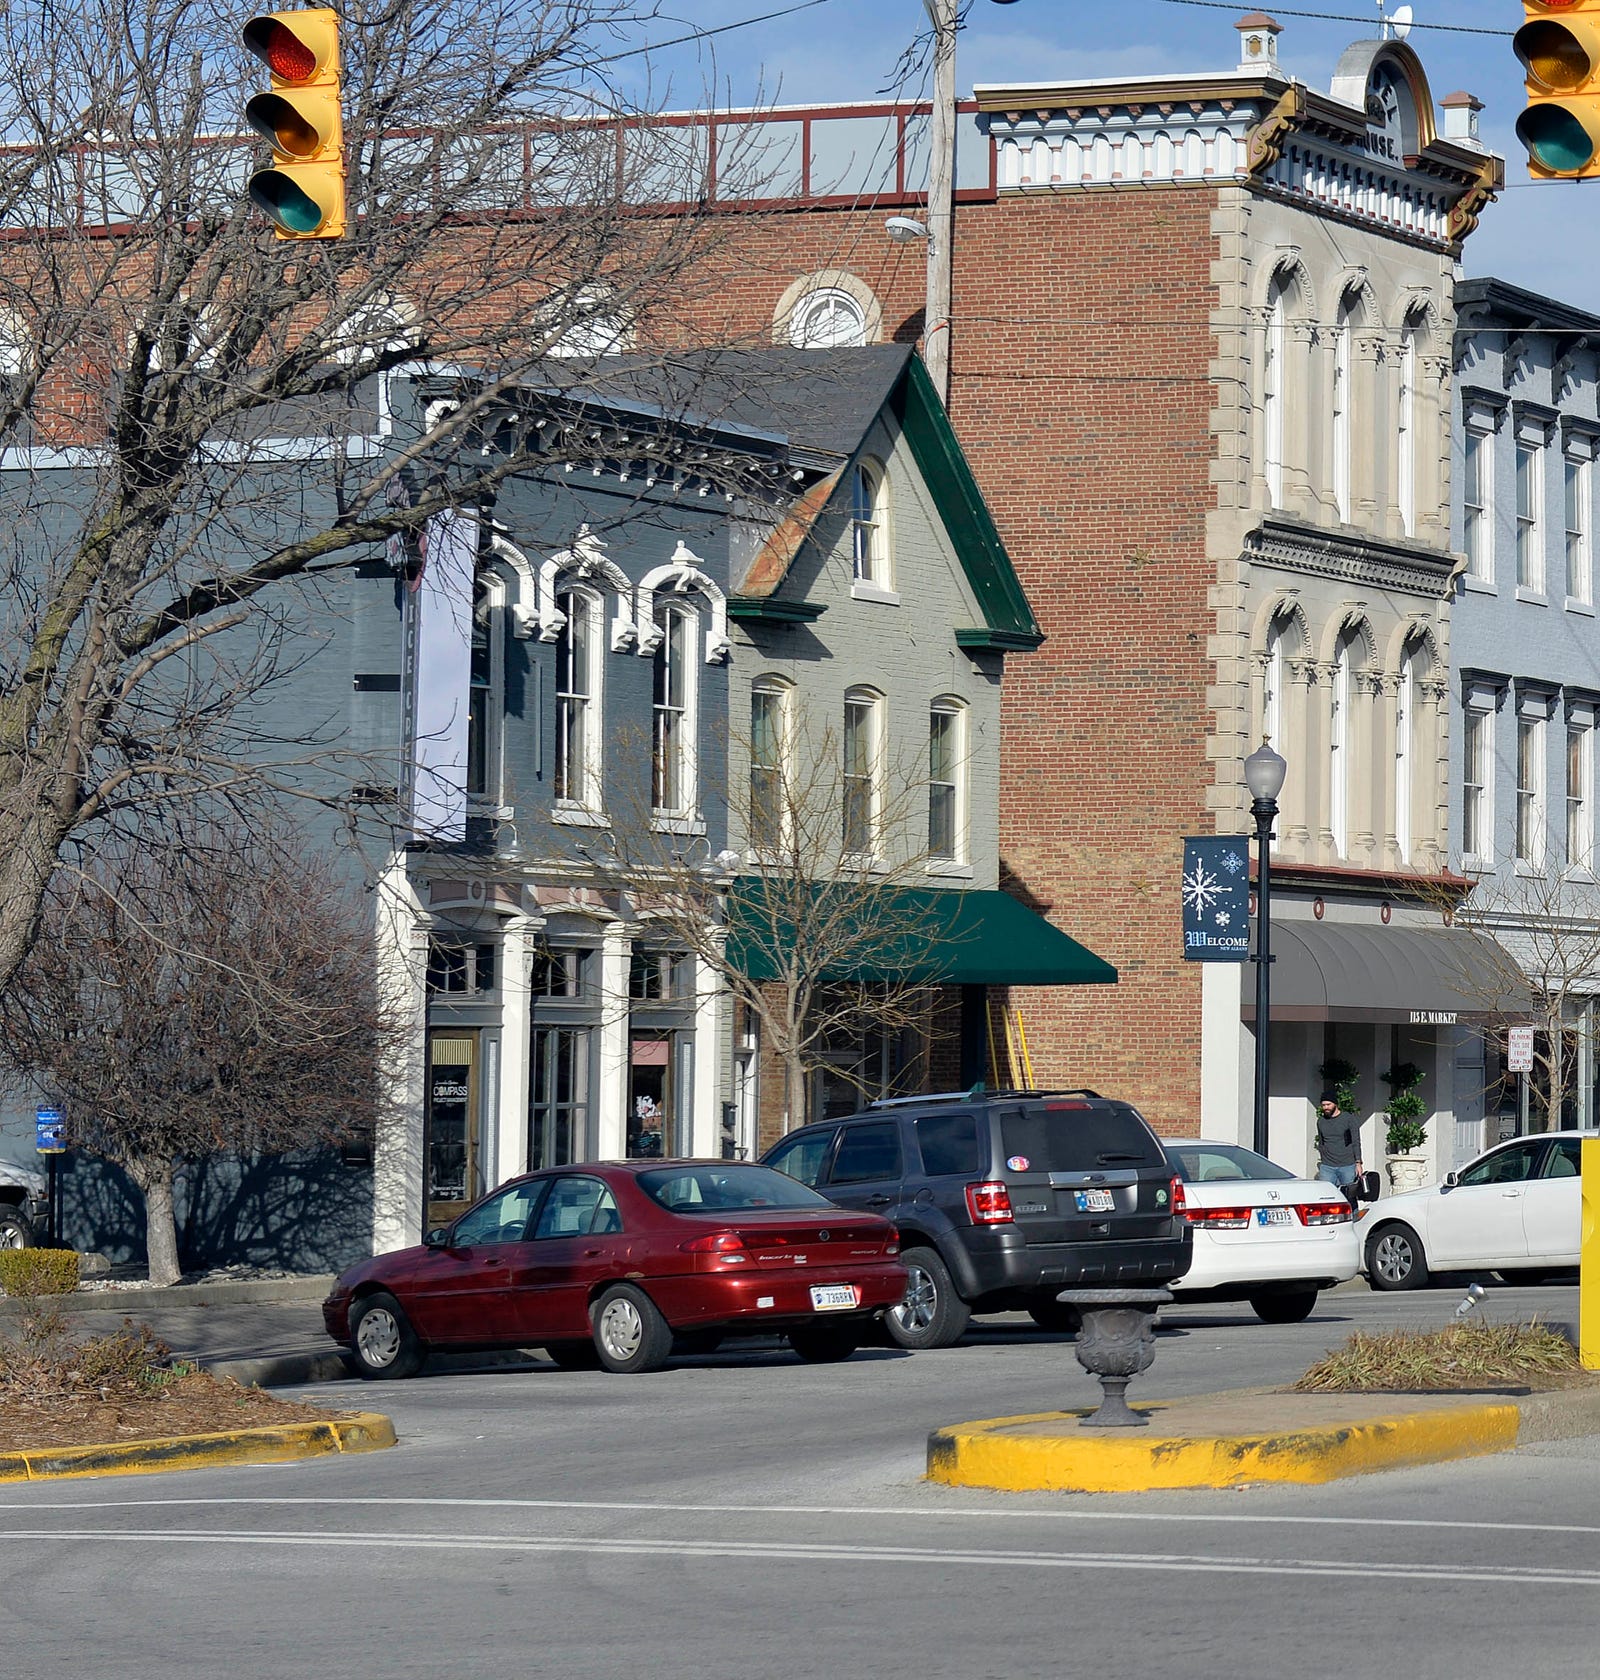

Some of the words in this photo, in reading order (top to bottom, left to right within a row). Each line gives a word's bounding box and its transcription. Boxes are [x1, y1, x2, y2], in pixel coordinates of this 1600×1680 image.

[1357, 131, 1399, 162] OUSE.
[406, 604, 414, 674] ICE
[1185, 930, 1249, 951] WELCOME
[1428, 1012, 1458, 1024] MARKET
